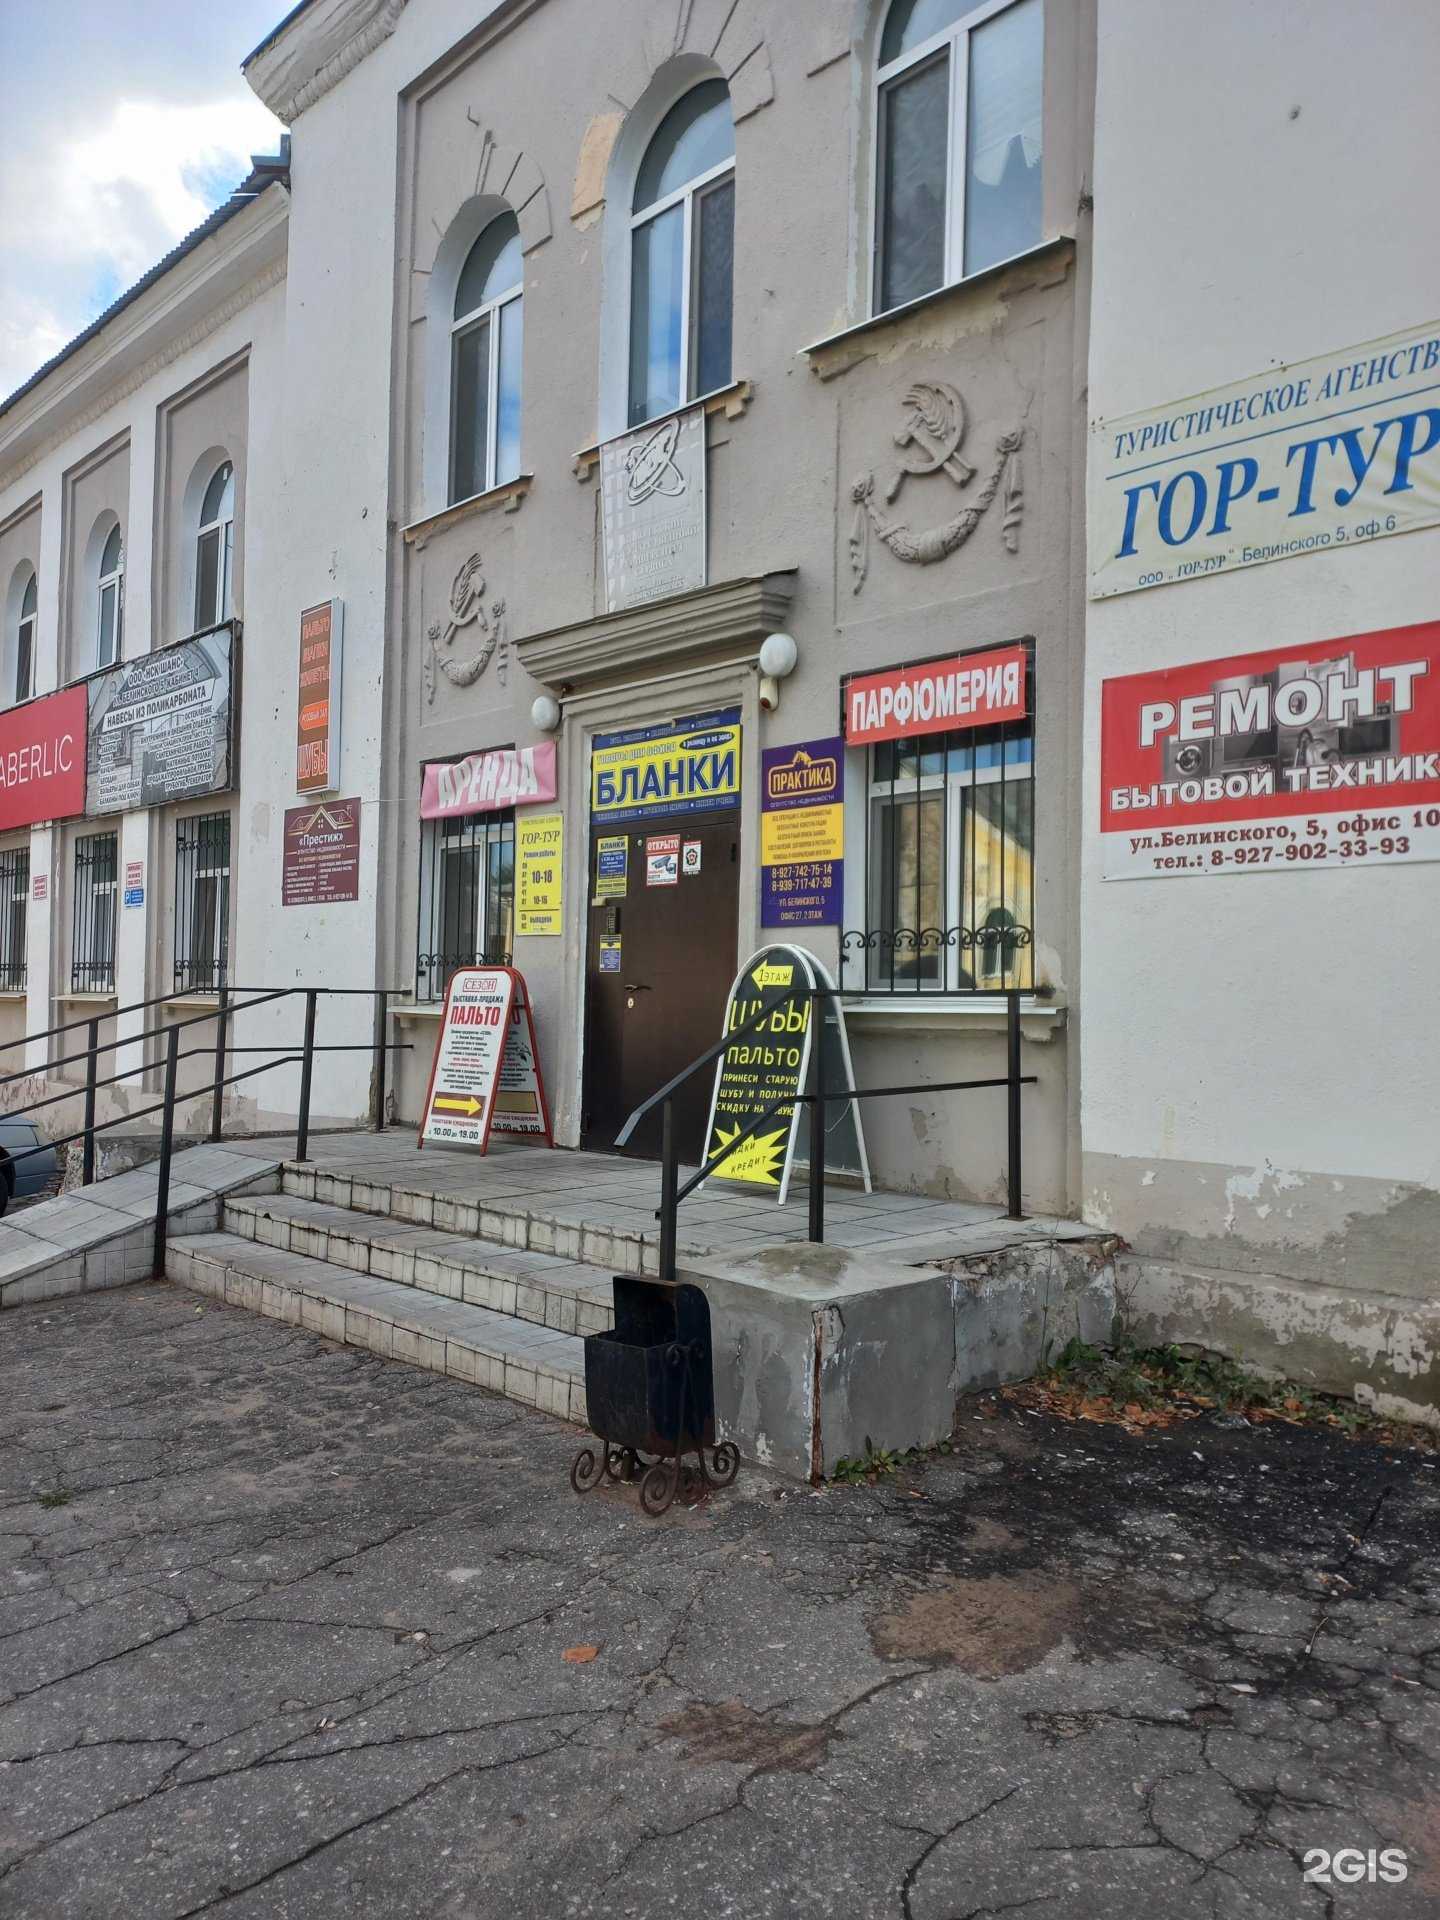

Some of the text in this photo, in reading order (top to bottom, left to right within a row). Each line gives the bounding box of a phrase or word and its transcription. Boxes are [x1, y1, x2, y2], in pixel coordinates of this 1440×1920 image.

[1114, 378, 1312, 459] ТУРИСТИЧЕСКОЕ
[1114, 407, 1440, 560] ГОР-ТУР
[1356, 520, 1380, 540] оф
[1386, 515, 1396, 531] 6
[107, 685, 206, 727] НАВЕСЫ ИЗ ПОЛИКАРБОНАТА
[852, 662, 1019, 732] ПАРФЮМЕРИЯ
[1138, 659, 1430, 748] РЕМОНТ
[297, 739, 328, 779] ШУБЫ
[438, 747, 538, 809] АРЕНДА
[596, 750, 735, 806] БЛАНКИ
[773, 766, 832, 792] ПРАКТИКА
[1110, 765, 1275, 812] БЫТОВОЙ
[521, 830, 560, 845] ГОР-ТУР
[1306, 820, 1328, 839] 5,
[1337, 814, 1401, 837] офис
[299, 833, 343, 847] «Престиж»
[601, 840, 625, 850] БЛАНКИ
[647, 840, 679, 852] ОТКРЫТО
[1154, 837, 1410, 870] тел.: 8-927-902-33-93
[532, 869, 552, 884] 10-18
[465, 980, 495, 990] СЕЗОН
[450, 1006, 501, 1026] ПАЛЬТО
[723, 1073, 799, 1085] ПРИНЕСИ СТАРУЮ
[720, 1089, 743, 1099] ШУБУ
[749, 1089, 754, 1099] И
[717, 1102, 749, 1114] СКИДКУ
[754, 1104, 764, 1113] НА
[433, 1127, 451, 1137] 10.00
[459, 1129, 479, 1139] 19.00
[731, 1156, 766, 1174] КРЕДИТ
